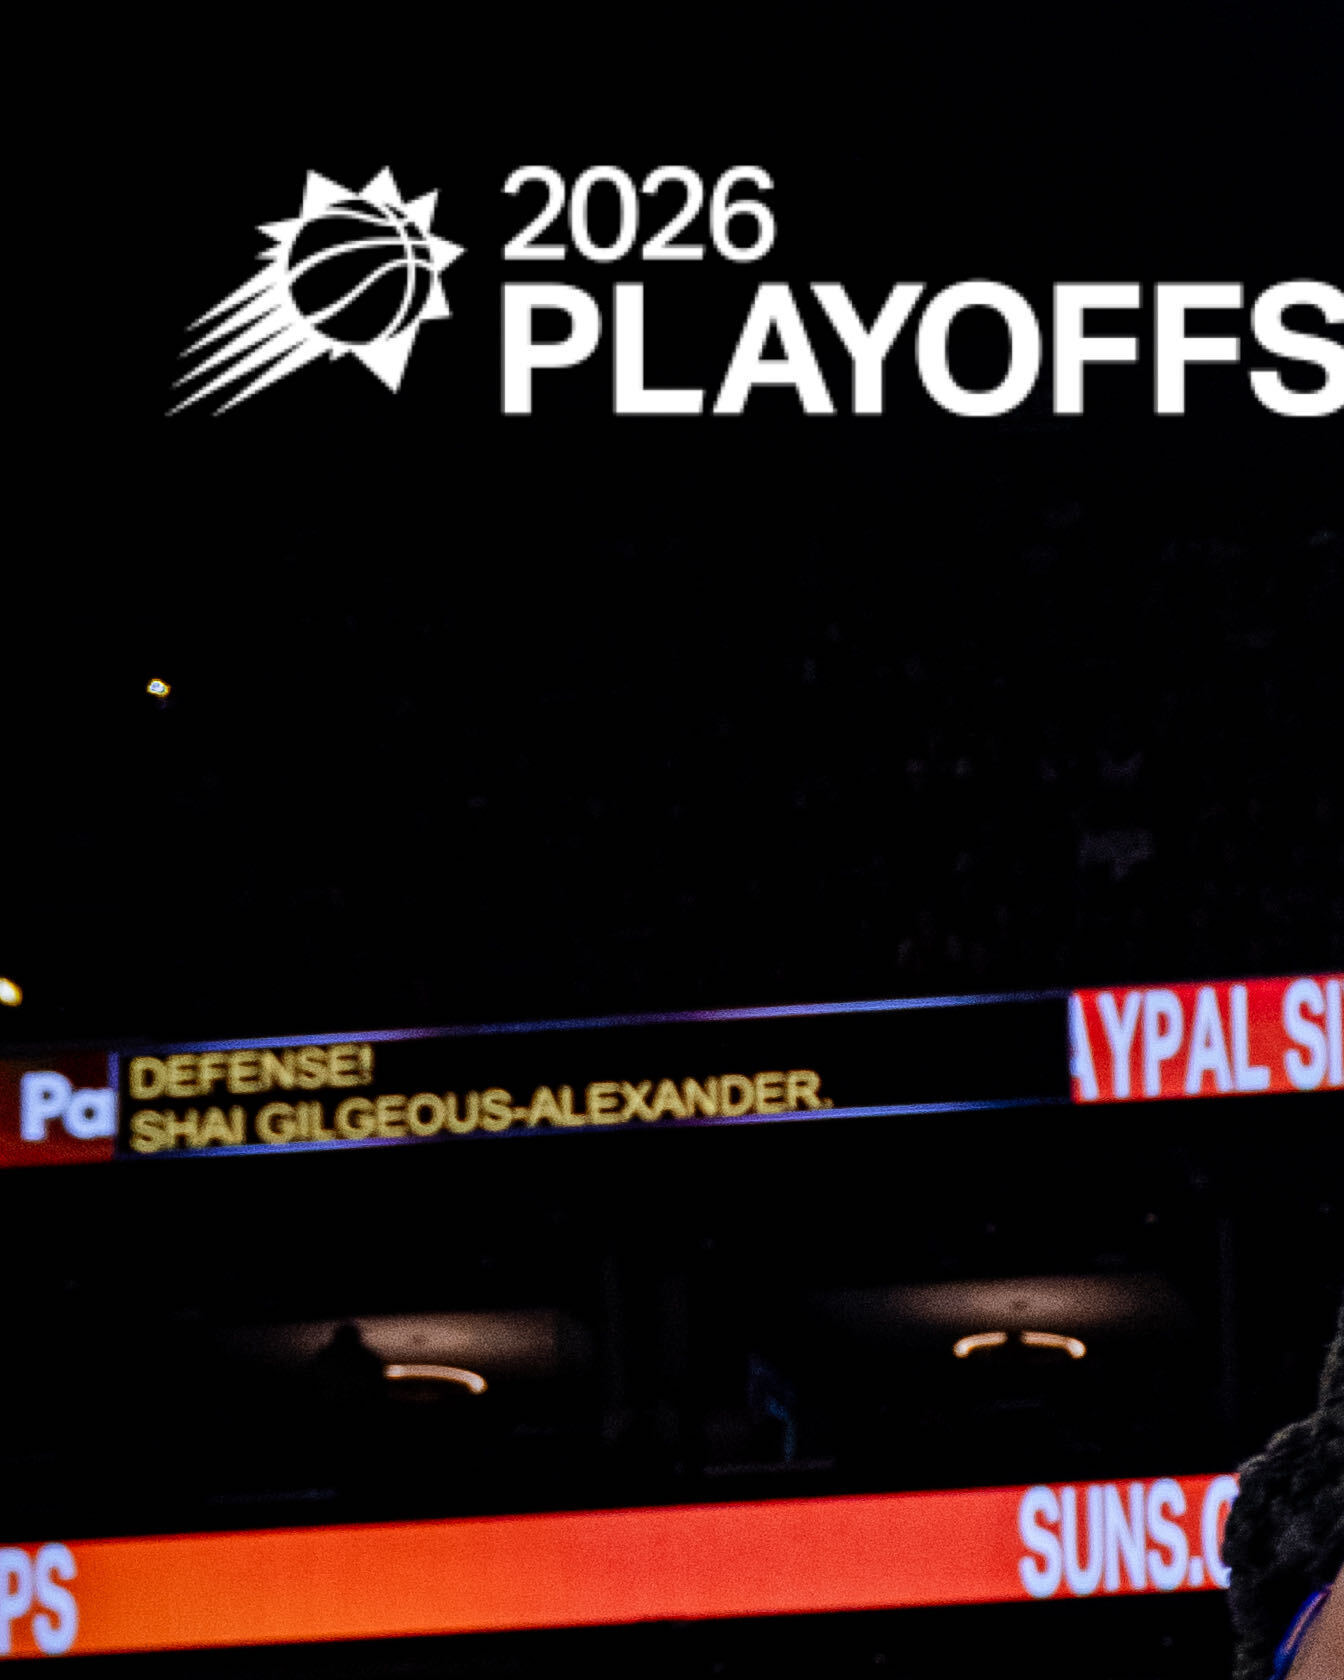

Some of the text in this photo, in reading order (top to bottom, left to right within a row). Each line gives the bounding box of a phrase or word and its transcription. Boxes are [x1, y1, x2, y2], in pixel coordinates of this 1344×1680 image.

[128, 1043, 376, 1101] DEFENSE!
[128, 1068, 835, 1154] SHAI GILGEOUS-ALEXANDER.
